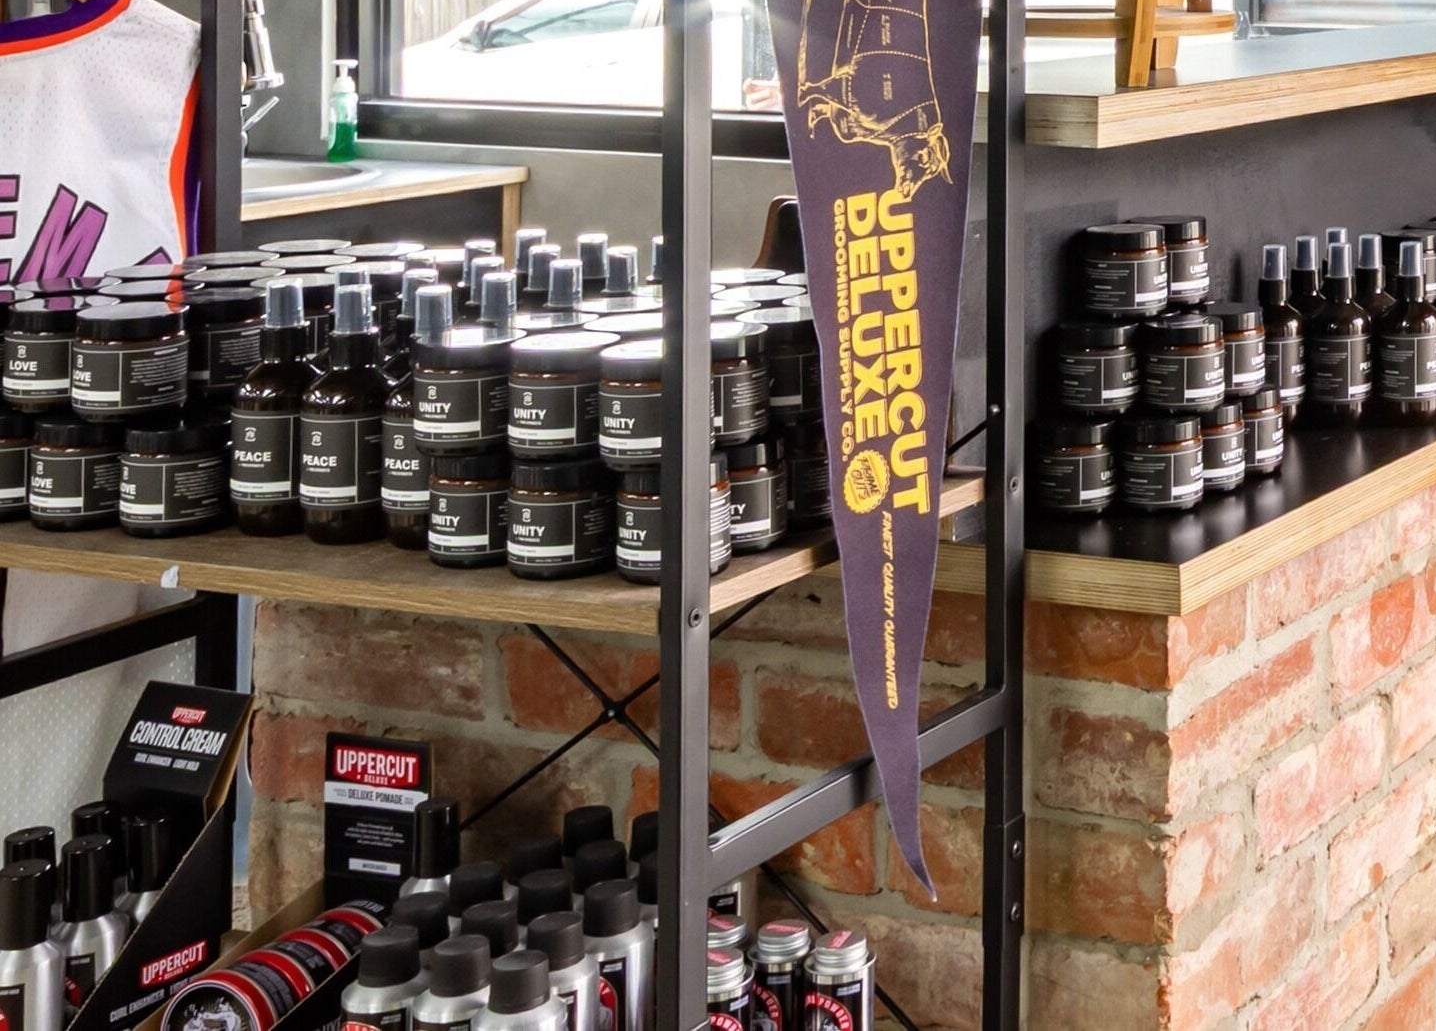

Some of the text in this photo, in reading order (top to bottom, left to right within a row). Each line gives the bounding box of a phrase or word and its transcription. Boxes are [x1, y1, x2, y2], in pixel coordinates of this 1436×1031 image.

[833, 198, 851, 323] GROOMING
[846, 192, 890, 444] DELUXE
[877, 188, 931, 516] UPPERCUT
[9, 360, 38, 372] LOVE
[839, 327, 854, 416] SUPPLY
[418, 402, 452, 414] UNITY
[513, 408, 547, 420] UNITY
[603, 416, 636, 429] UNITY
[234, 449, 272, 463] PEACE
[303, 454, 338, 468] PEACE
[384, 458, 420, 471] PEACE
[31, 477, 54, 489] LOVE
[430, 515, 461, 527] UNITY
[512, 525, 546, 537] UNITY
[618, 528, 648, 541] UNITY
[881, 510, 899, 710] FINEST QUALITY GUARANTEED
[129, 720, 227, 757] CONTROL CREAM
[336, 748, 417, 784] UPPERCUT
[347, 788, 374, 802] DELUXE
[375, 791, 404, 806] POMADE
[142, 940, 207, 986] UPPERCUT
